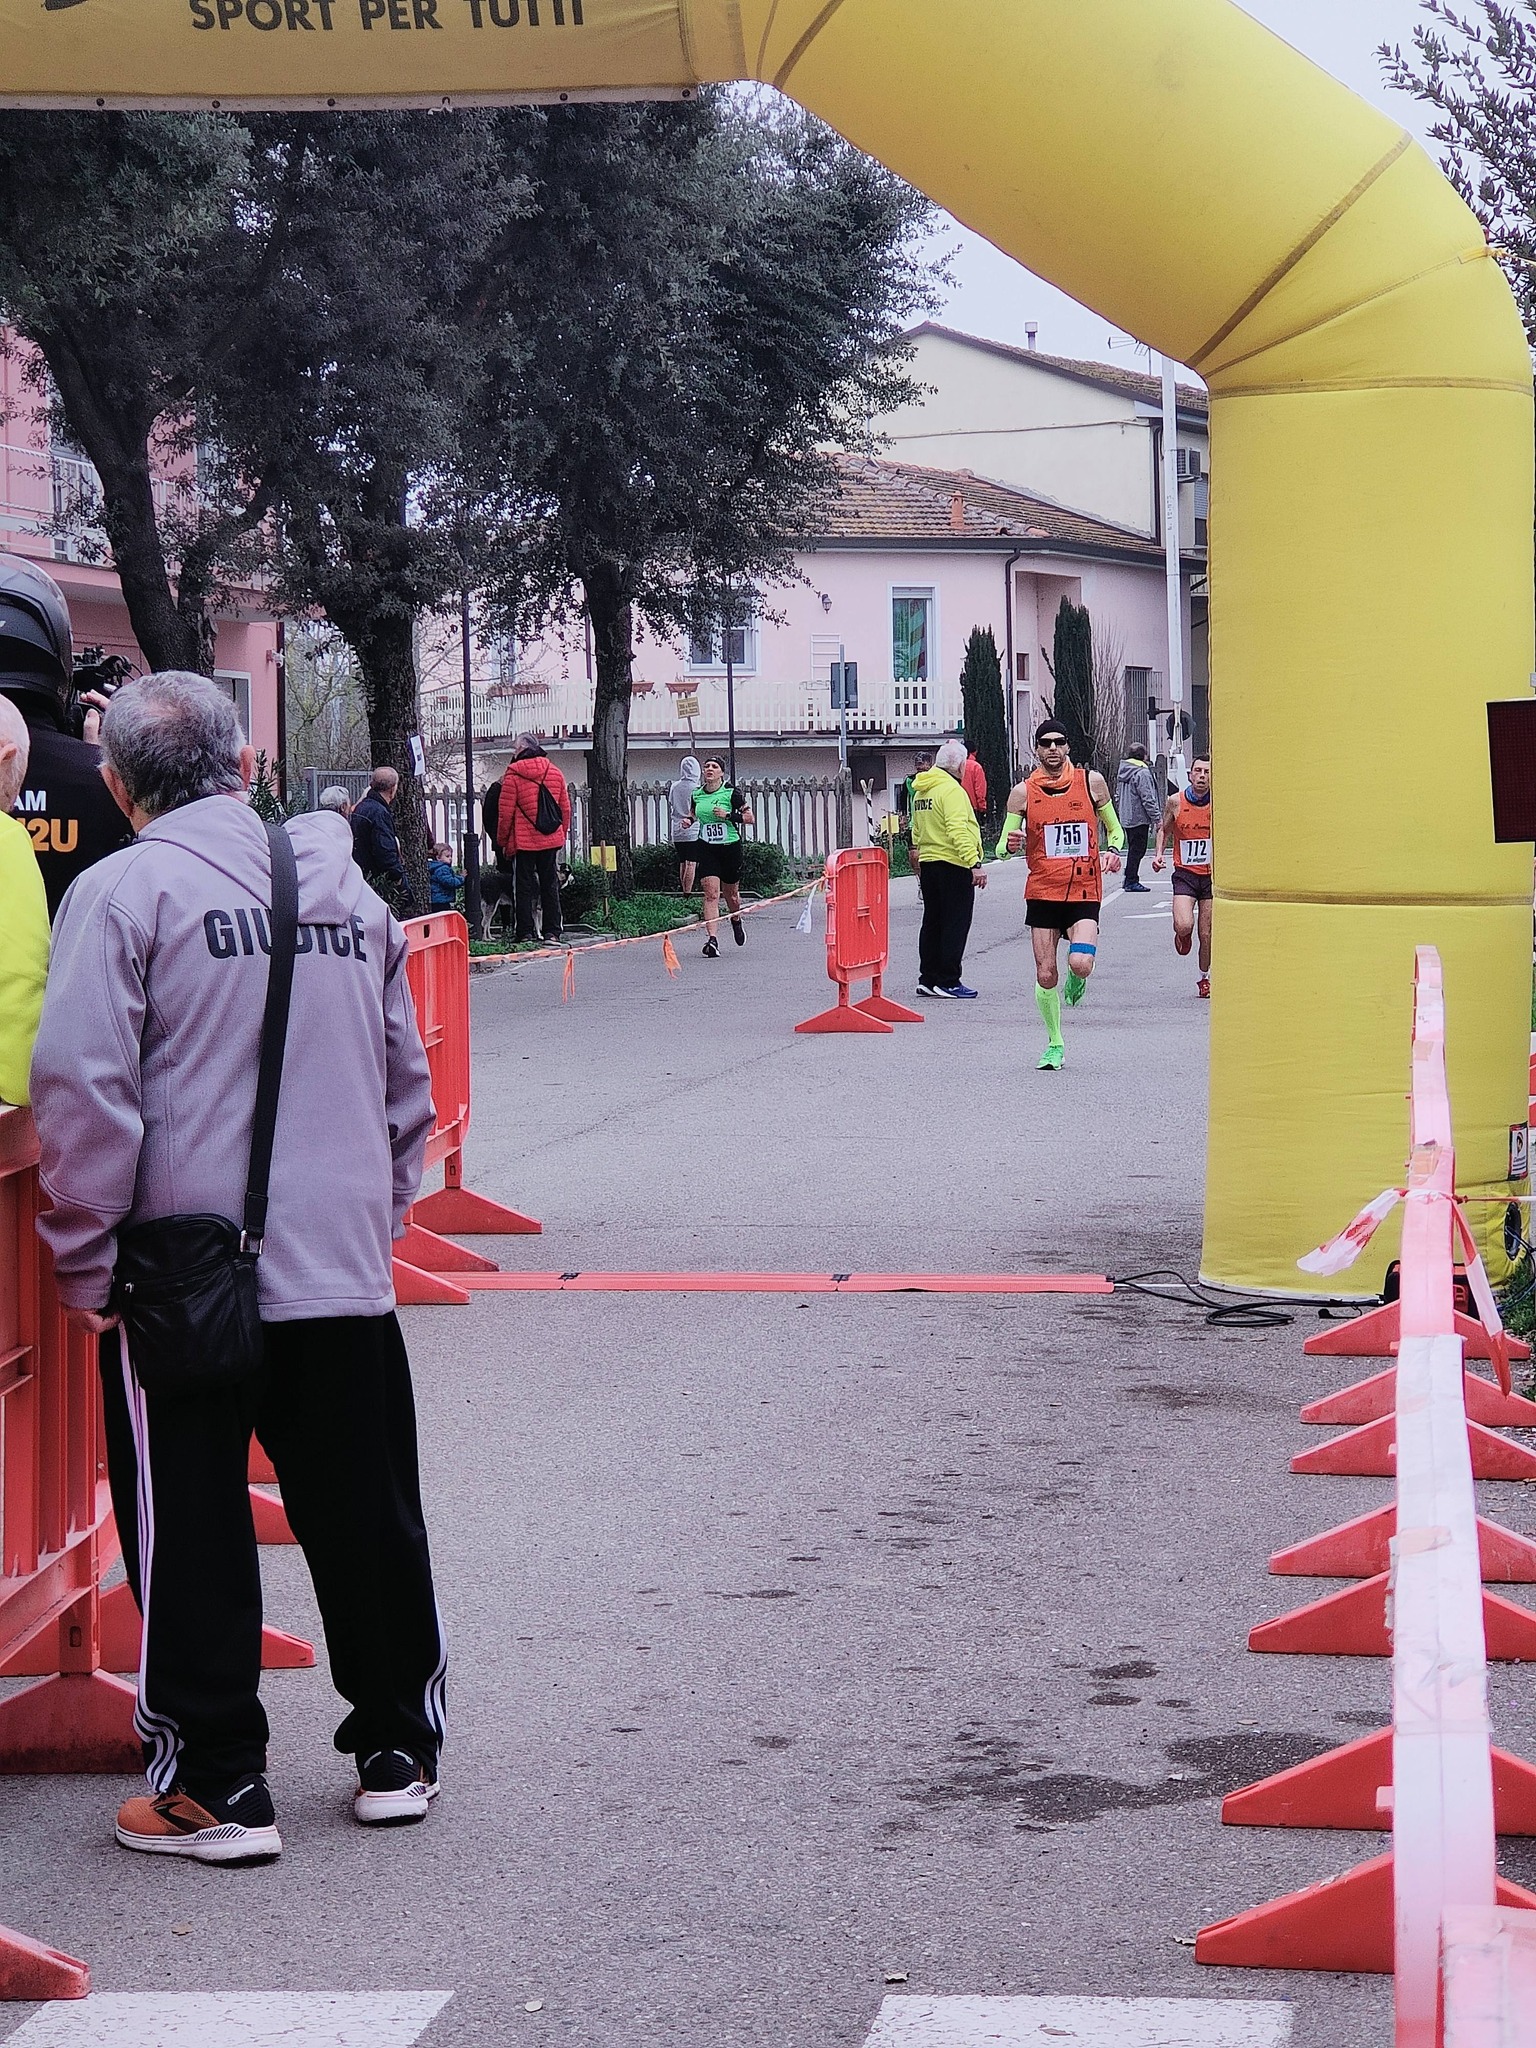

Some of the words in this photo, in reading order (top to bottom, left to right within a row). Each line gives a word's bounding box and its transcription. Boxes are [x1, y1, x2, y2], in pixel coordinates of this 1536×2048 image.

[191, 0, 335, 31] SPORT
[358, 0, 443, 30] PER
[462, 0, 584, 28] TUTTI
[16, 817, 79, 852] 2U
[706, 824, 723, 837] 535
[1054, 824, 1081, 846] 755
[1186, 841, 1207, 856] 772
